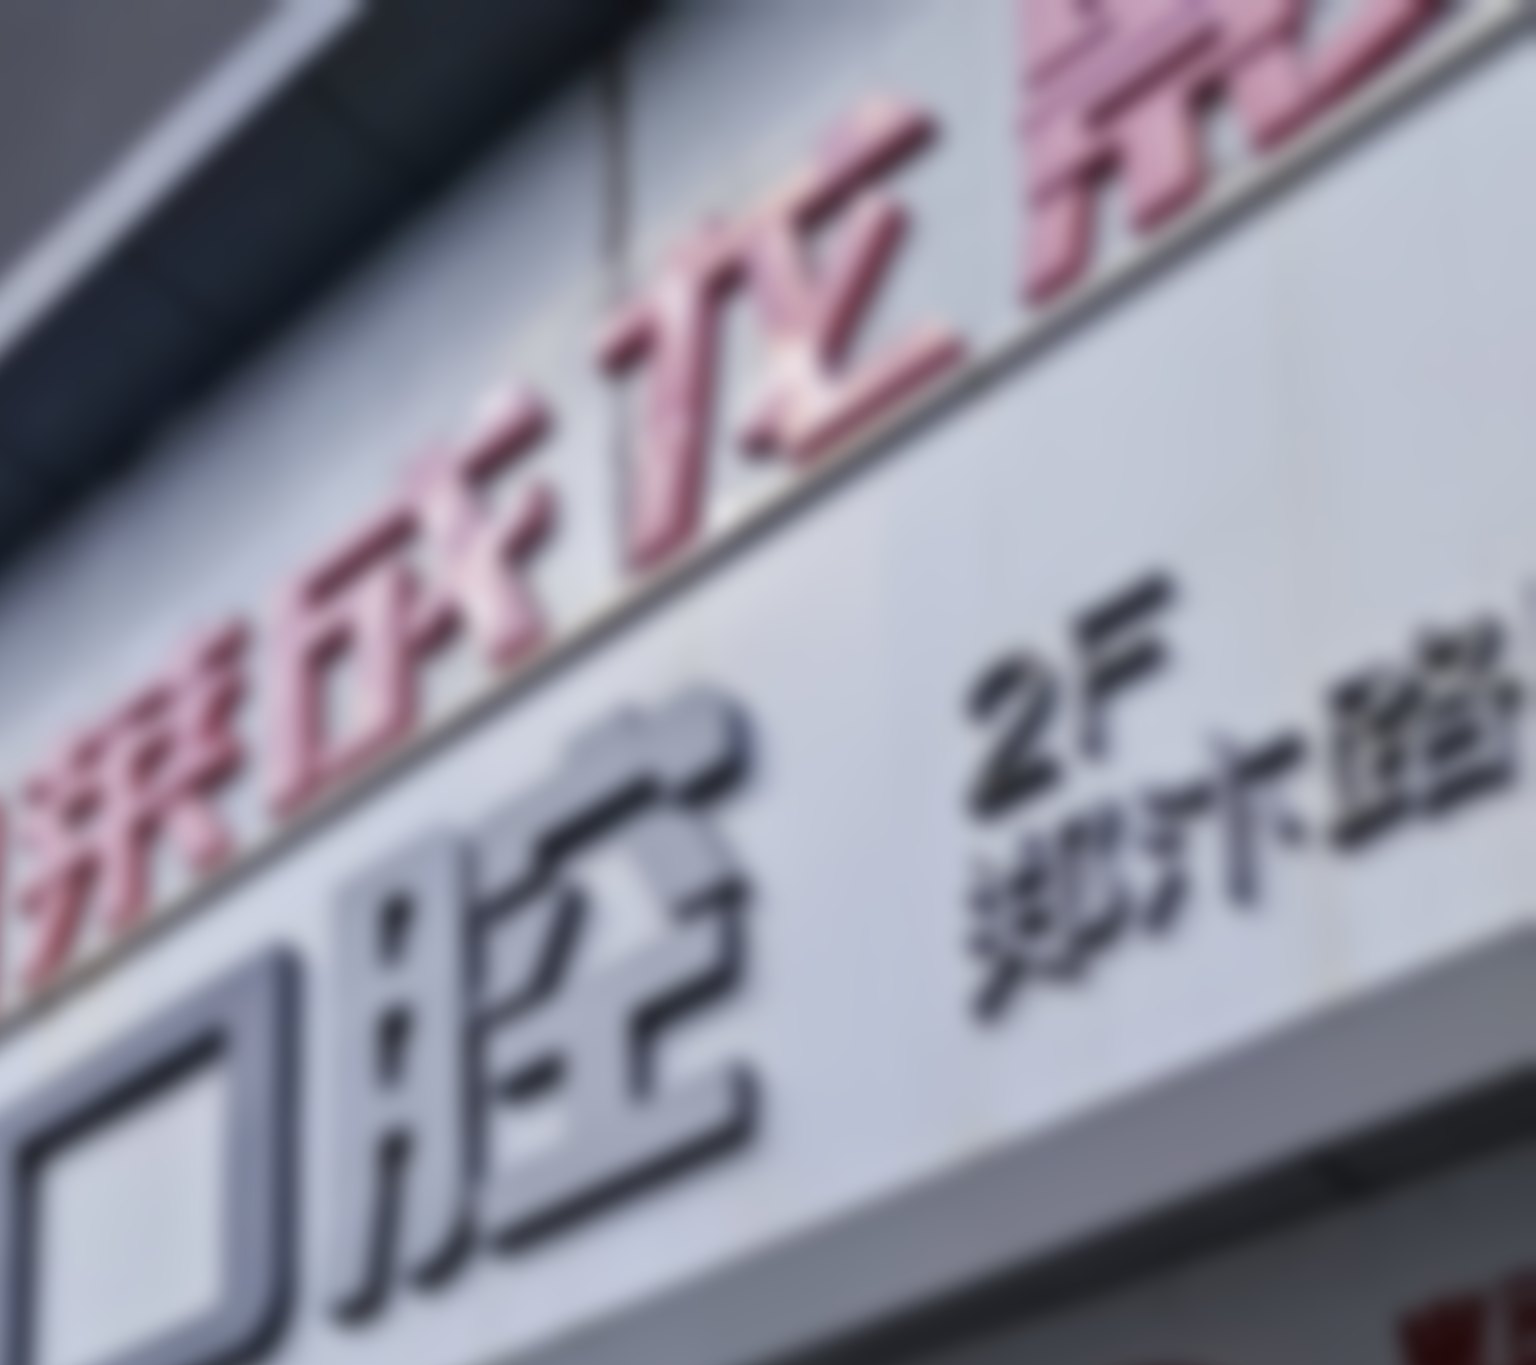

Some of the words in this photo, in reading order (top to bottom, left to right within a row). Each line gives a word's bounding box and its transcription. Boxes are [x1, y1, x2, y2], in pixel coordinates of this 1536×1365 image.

[959, 590, 1536, 1025] 郑汴路
[962, 570, 1180, 822] 2F
